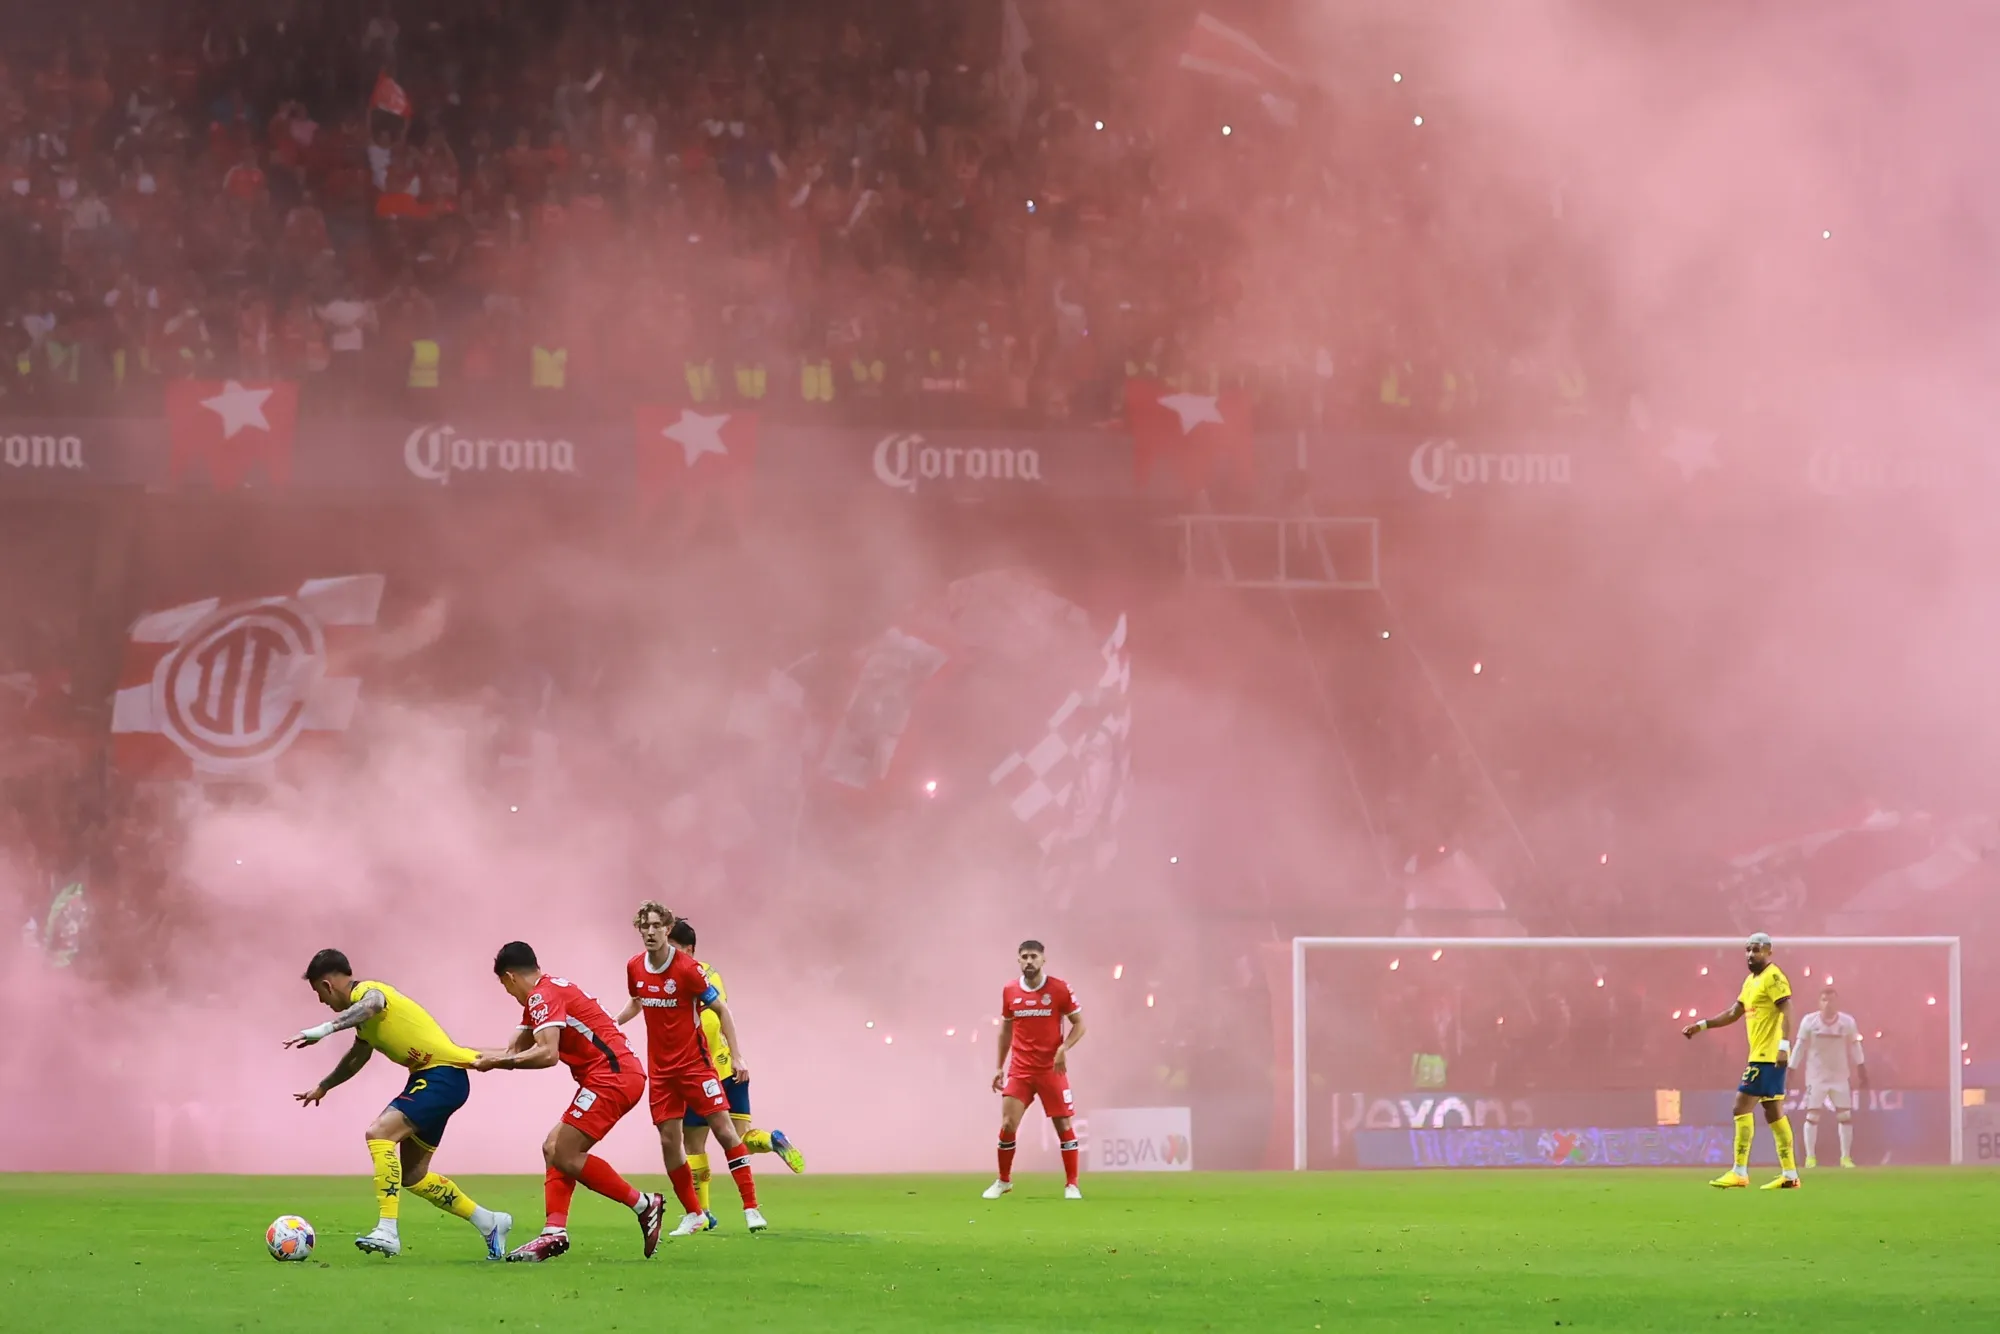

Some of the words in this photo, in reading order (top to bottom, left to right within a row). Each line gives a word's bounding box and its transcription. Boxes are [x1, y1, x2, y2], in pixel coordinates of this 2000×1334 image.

[0, 434, 84, 468] ona
[404, 424, 578, 486] Corona
[873, 433, 1042, 493] Corona
[1409, 439, 1573, 498] Corona
[1742, 1066, 1759, 1082] 27
[1103, 1137, 1158, 1166] BBVA
